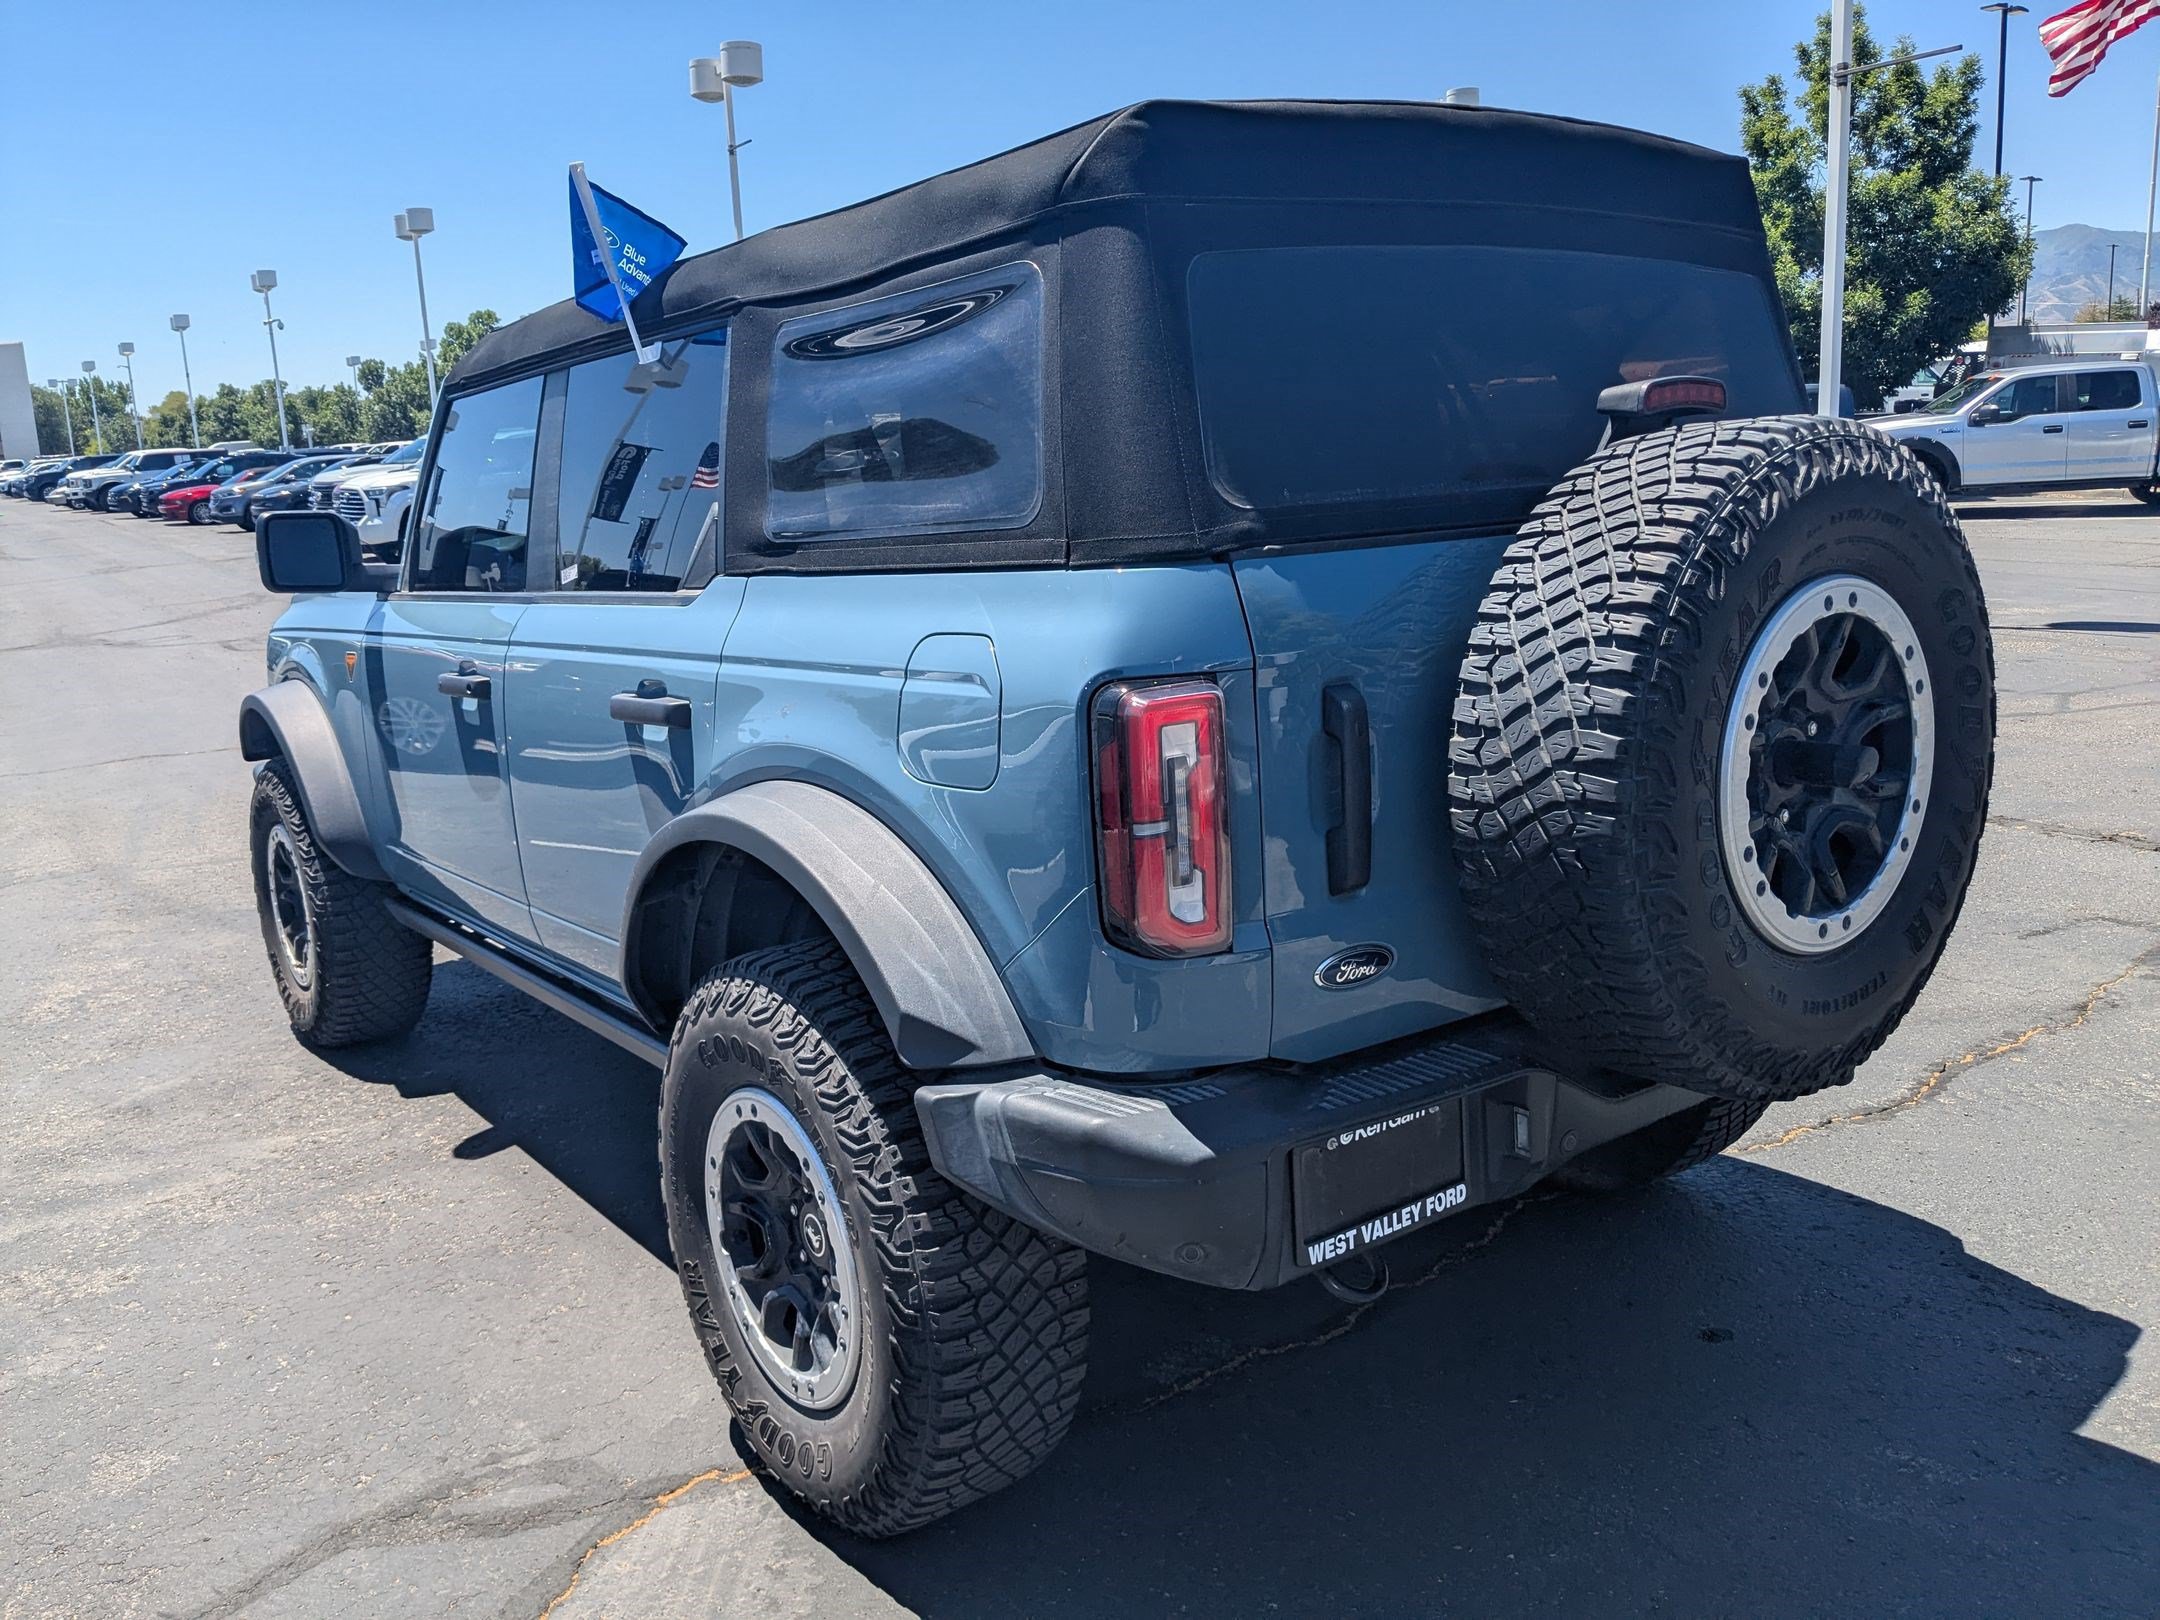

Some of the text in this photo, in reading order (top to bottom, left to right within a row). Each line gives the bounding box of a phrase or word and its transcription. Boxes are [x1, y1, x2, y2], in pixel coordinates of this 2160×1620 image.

[623, 243, 647, 267] Blue
[1335, 955, 1379, 983] Ford
[1308, 1183, 1467, 1266] WEST VALLEY FORD
[685, 1259, 834, 1484] GOODYEAR
